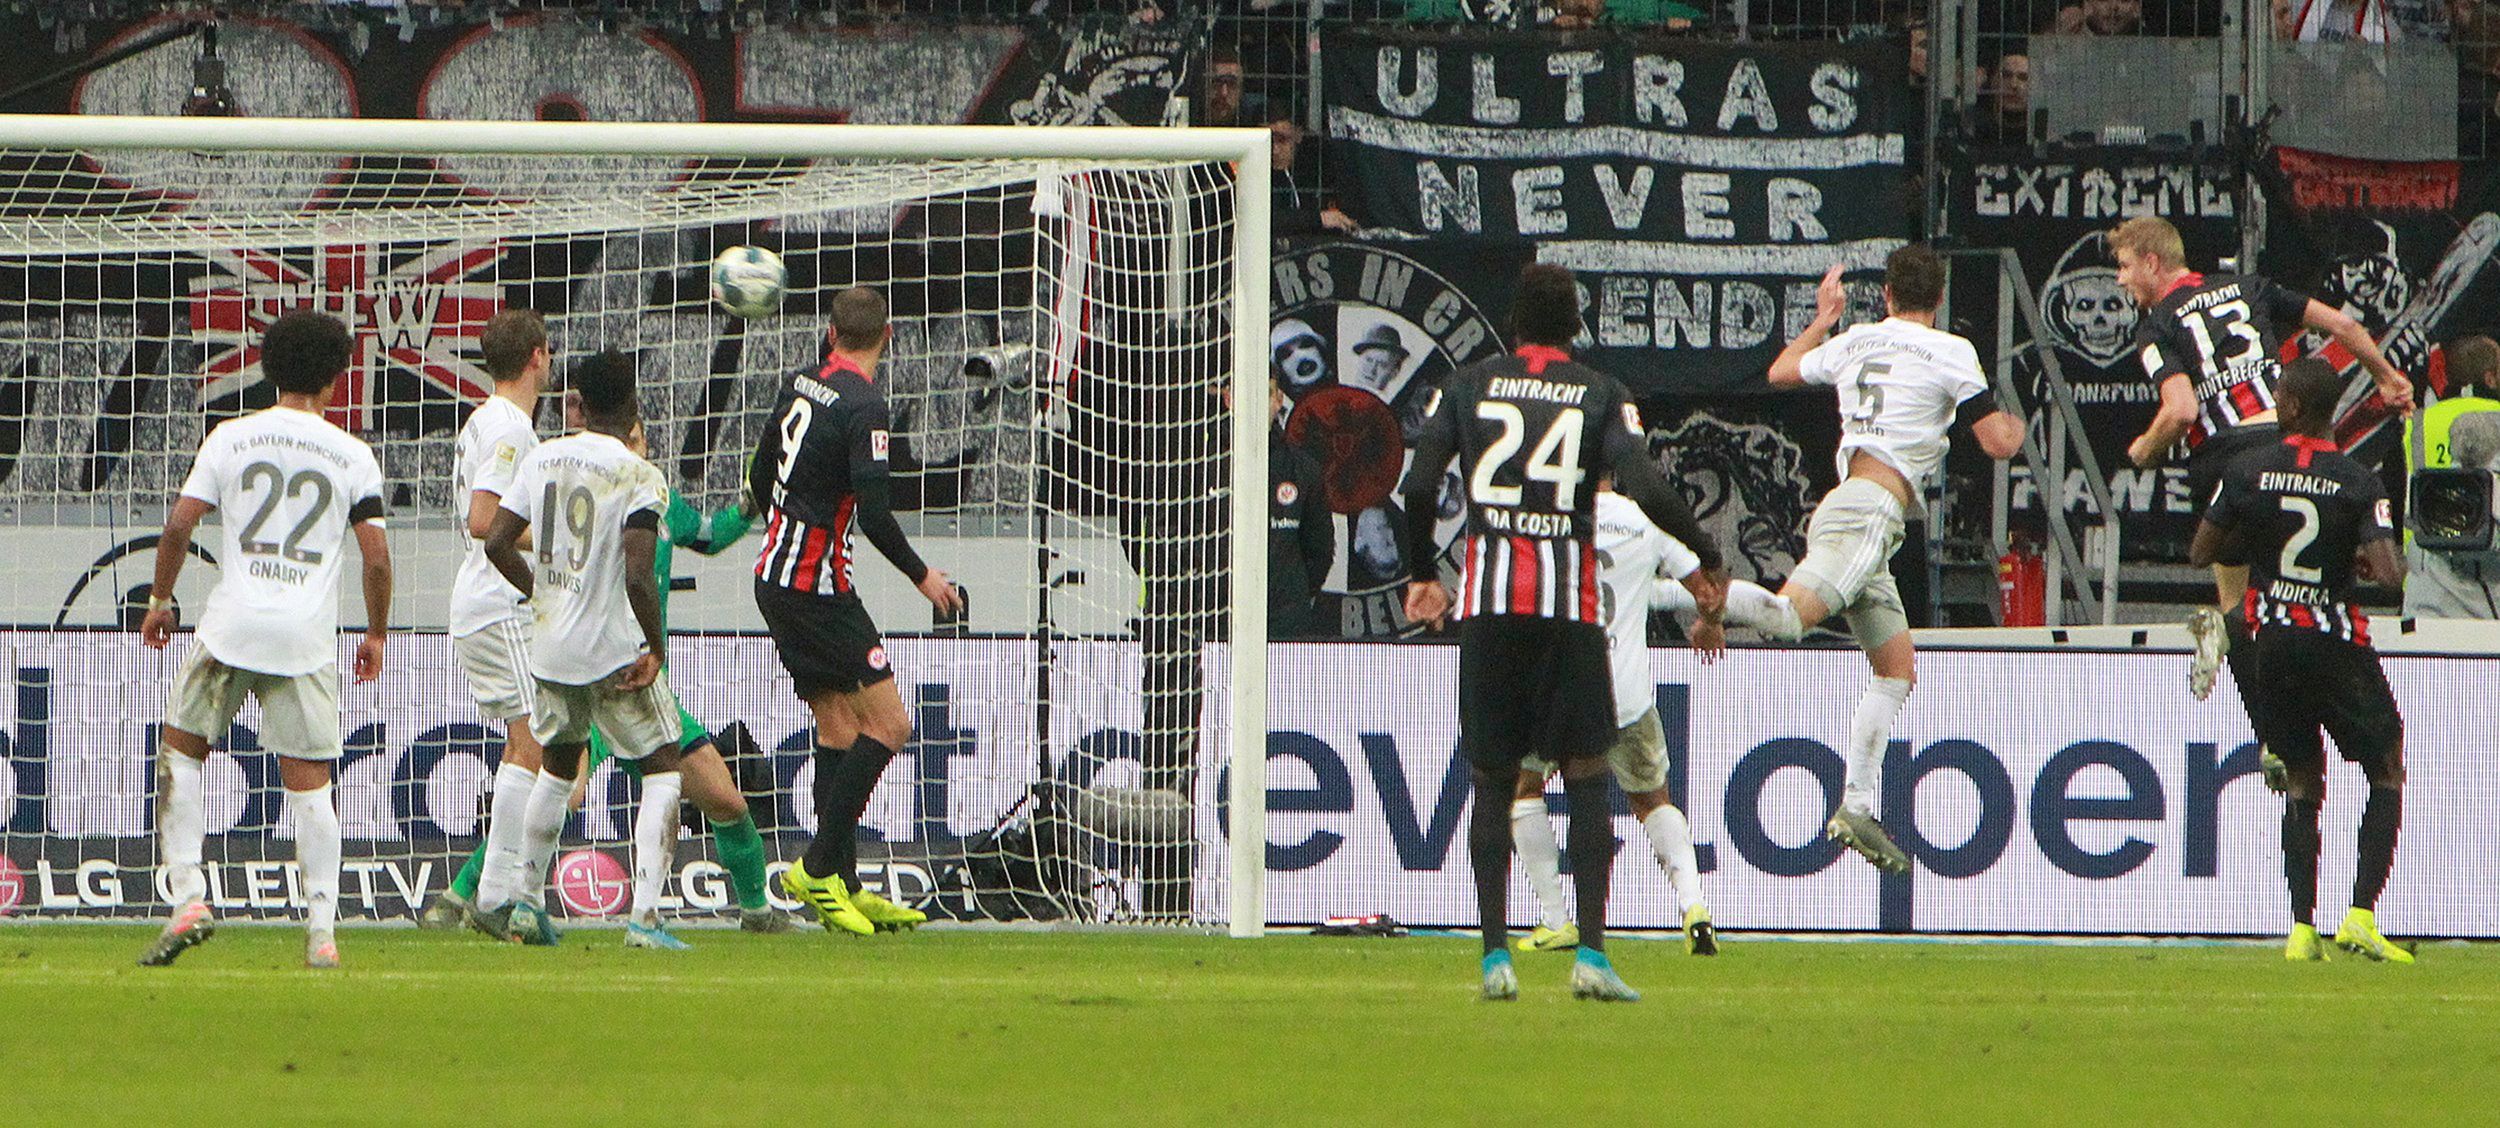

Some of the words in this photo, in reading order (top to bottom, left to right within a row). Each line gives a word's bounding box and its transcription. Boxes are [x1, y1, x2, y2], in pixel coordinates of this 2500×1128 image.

[1377, 46, 1859, 132] ULTRAS
[1416, 161, 1828, 240] NEVER
[1974, 164, 2234, 219] EXTREME
[1359, 252, 1415, 309] IN
[2175, 283, 2242, 318] EINTRACHT
[2181, 299, 2264, 379] 13
[1488, 377, 1588, 404] EINTRACHT
[1852, 362, 1893, 426] 5
[2195, 358, 2276, 401] HINTEREGG
[232, 443, 248, 455] FC
[250, 434, 294, 449] BAYERN
[780, 397, 813, 484] 9
[1470, 401, 1586, 511] 24
[2259, 471, 2342, 496] EINTRACHT
[238, 461, 333, 565] 22
[540, 480, 595, 572] 19
[1485, 508, 1512, 529] DA
[1515, 511, 1573, 537] COSTA
[2280, 495, 2323, 584] 2
[249, 560, 309, 586] GNABRY
[2269, 579, 2331, 605] NDICKA
[37, 858, 124, 908] LG
[343, 860, 432, 909] TV
